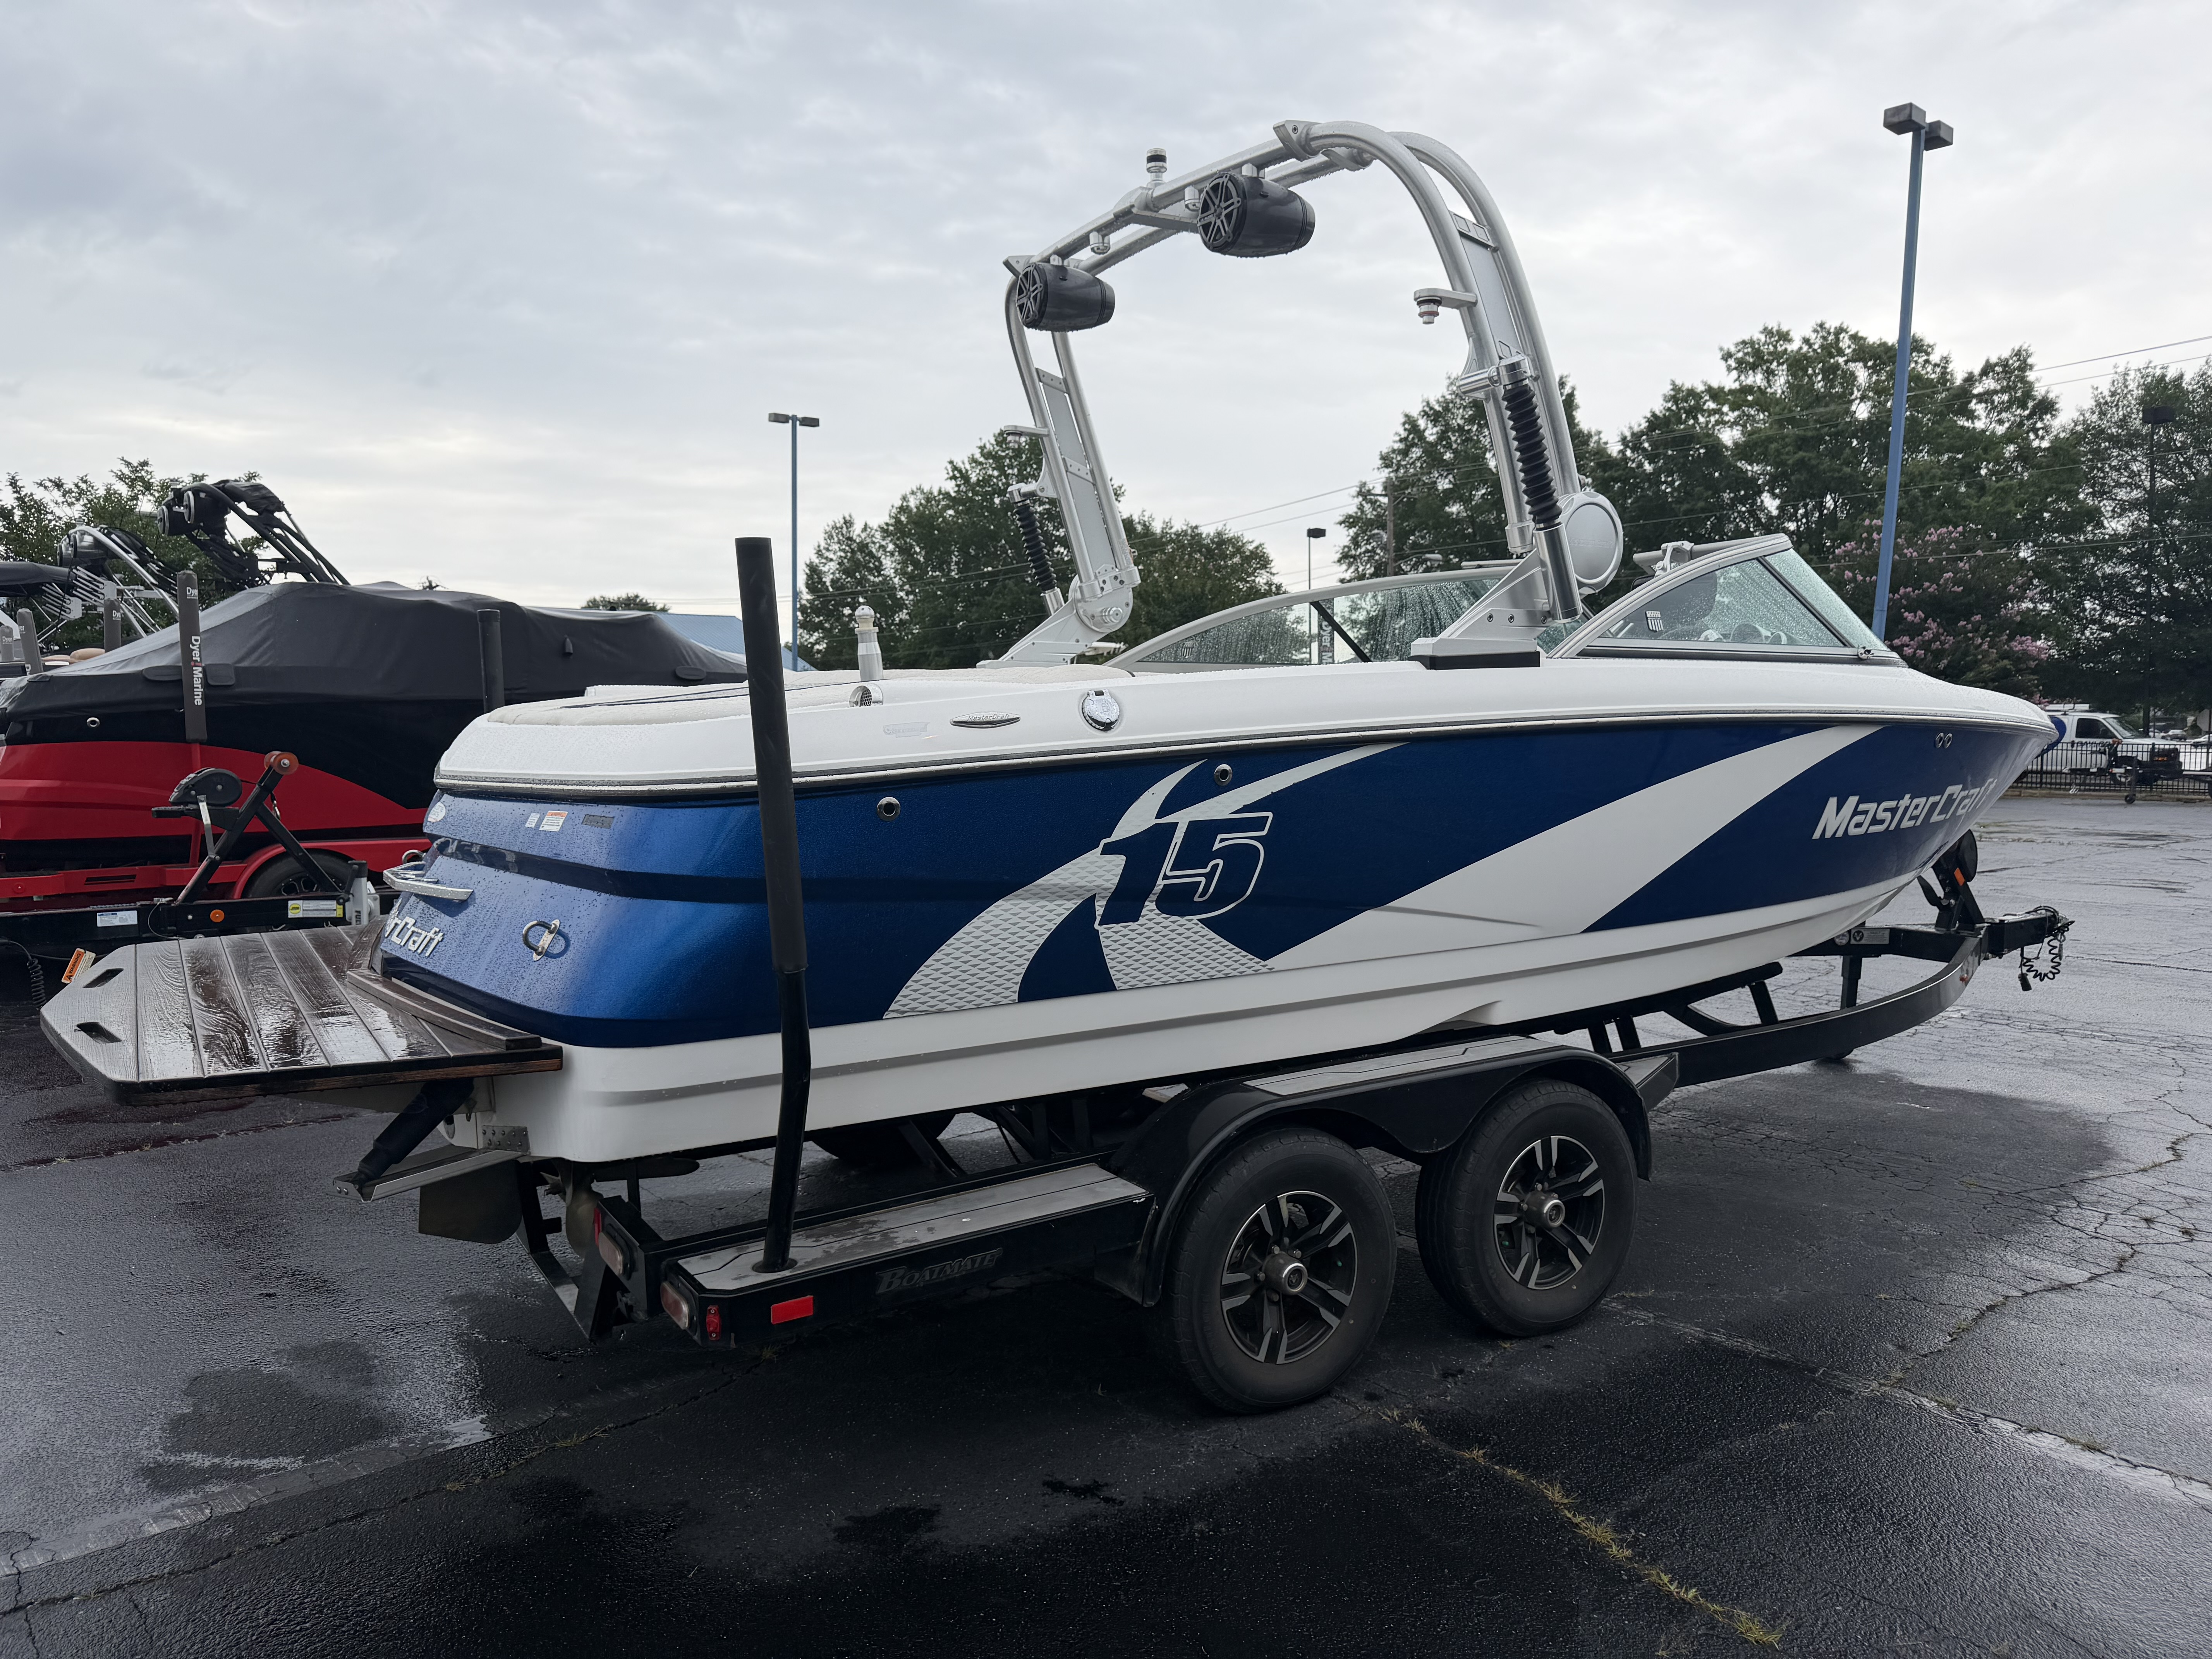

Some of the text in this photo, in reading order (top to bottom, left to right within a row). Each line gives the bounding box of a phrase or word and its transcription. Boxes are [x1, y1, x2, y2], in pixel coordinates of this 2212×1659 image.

[187, 587, 198, 596] Dye
[1812, 778, 1997, 839] MasterCraft
[875, 1247, 1003, 1294] BOATMATE
